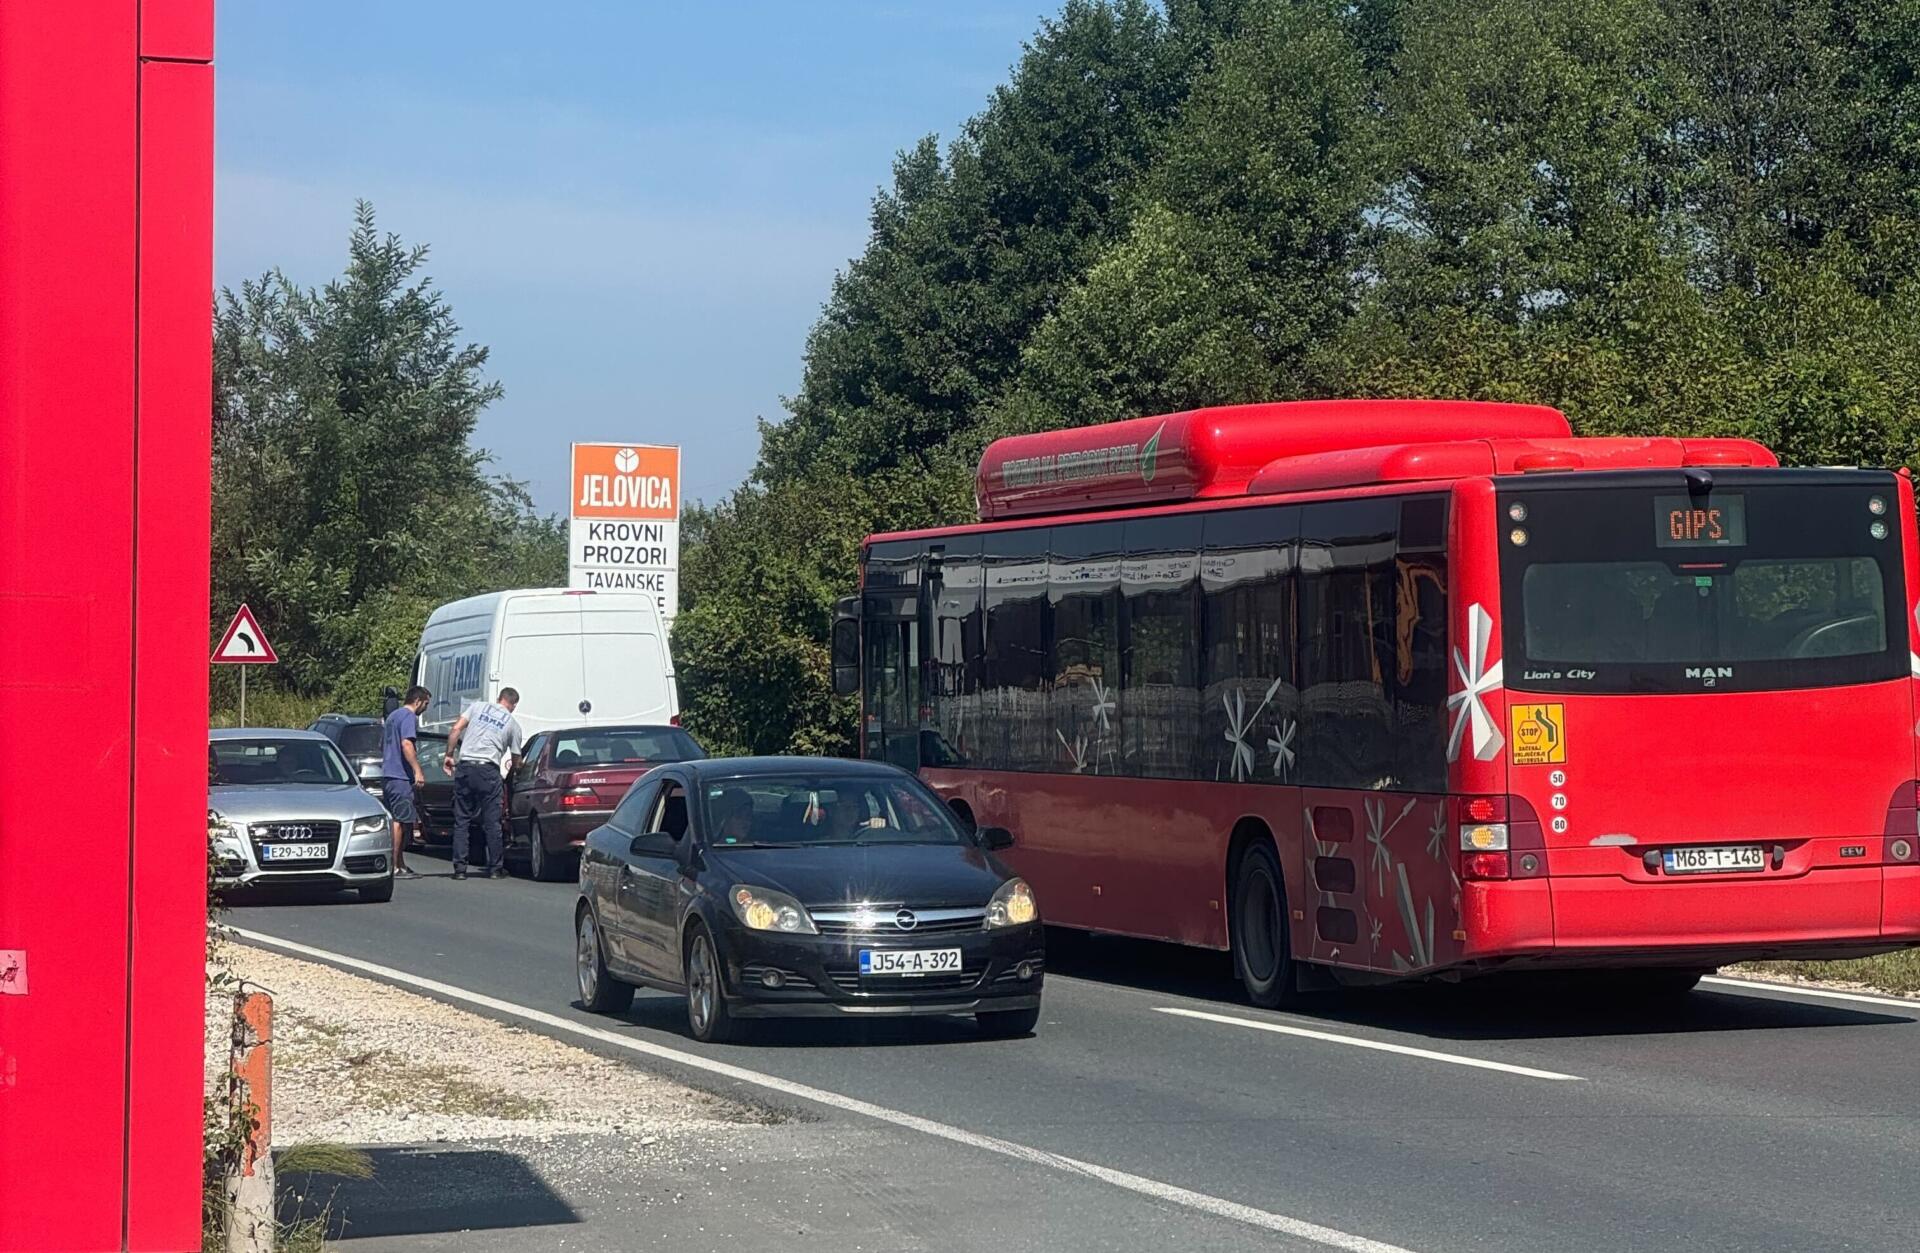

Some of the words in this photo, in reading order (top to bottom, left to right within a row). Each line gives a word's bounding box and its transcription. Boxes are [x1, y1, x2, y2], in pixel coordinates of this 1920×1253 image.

[580, 474, 672, 509] JELOVICA
[589, 523, 663, 542] KROVNI
[1670, 510, 1722, 540] GIPS
[583, 546, 667, 565] PROZORI
[586, 572, 664, 592] TAVANSKE
[453, 653, 482, 692] FAMM
[1523, 670, 1562, 680] Lion's
[1566, 669, 1596, 680] City
[1685, 667, 1733, 678] MAN
[1521, 728, 1538, 737] STOP
[1552, 774, 1563, 784] 50
[1554, 797, 1565, 807] 70
[1554, 820, 1565, 830] 80
[271, 846, 327, 858] E29-J-928
[1675, 848, 1761, 867] M68-T-148
[1841, 847, 1865, 856] EEV
[873, 952, 958, 971] J54-A-392
